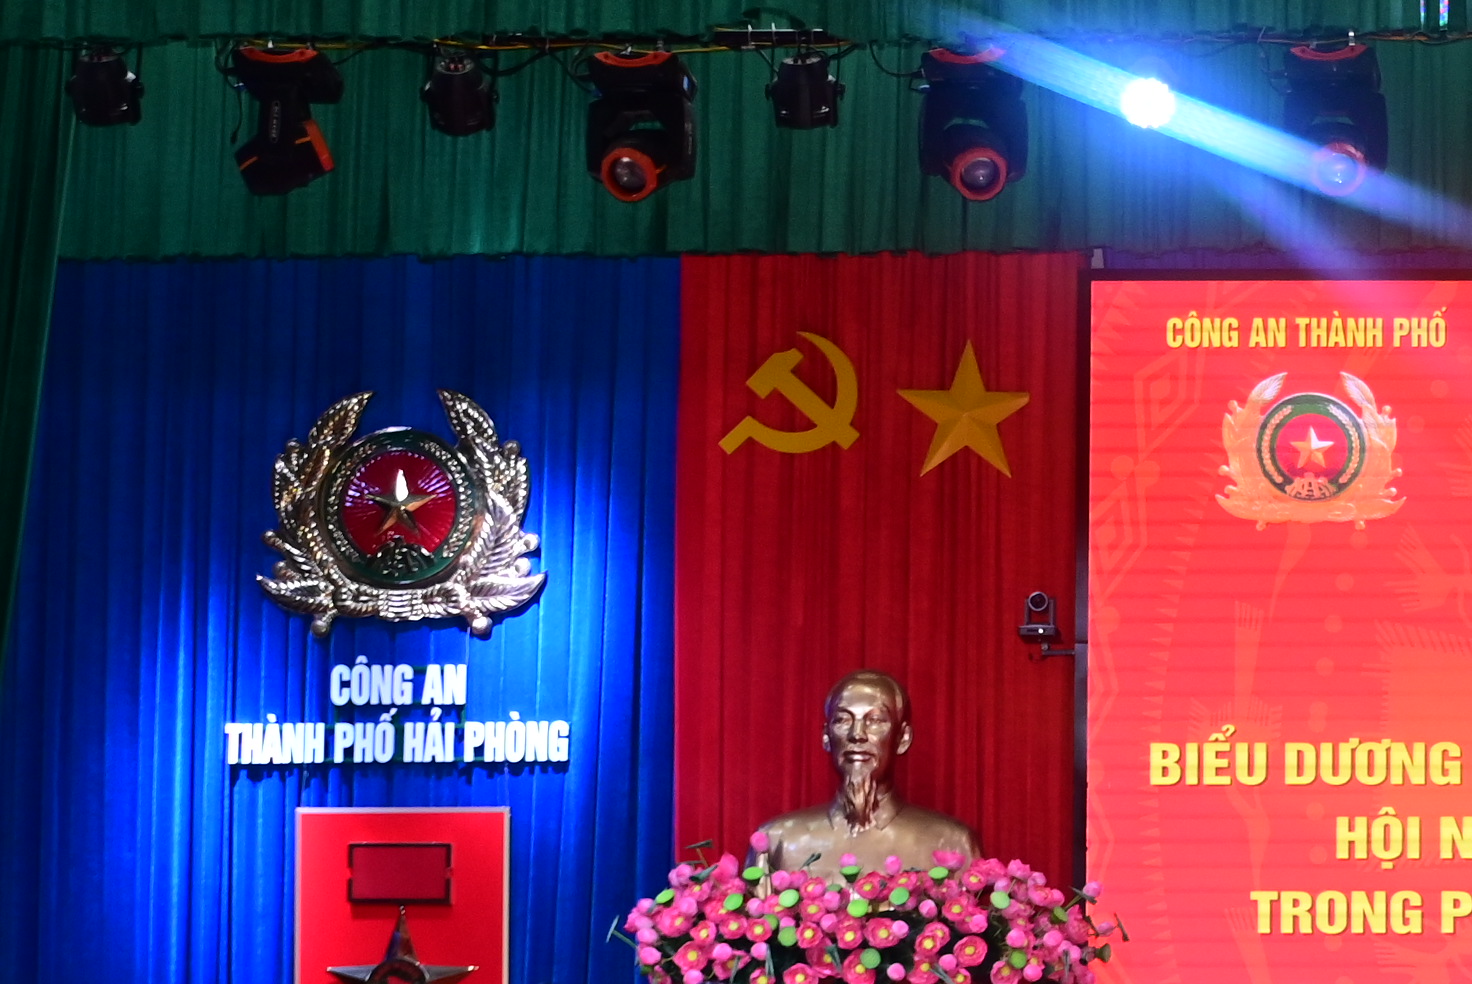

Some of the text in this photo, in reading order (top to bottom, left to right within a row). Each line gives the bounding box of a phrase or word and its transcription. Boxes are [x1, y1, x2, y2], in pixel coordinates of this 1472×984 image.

[1166, 306, 1447, 348] CÔNG AN THÀNH PHỐ
[330, 655, 468, 706] CÔNG AN
[224, 707, 570, 765] THÀNH PHỐ HẢI PHÒNG
[1149, 723, 1267, 786] BIỂU
[1284, 737, 1462, 786] DƯƠNG
[1335, 805, 1421, 870] HỘI
[1249, 890, 1423, 935] TRONG
